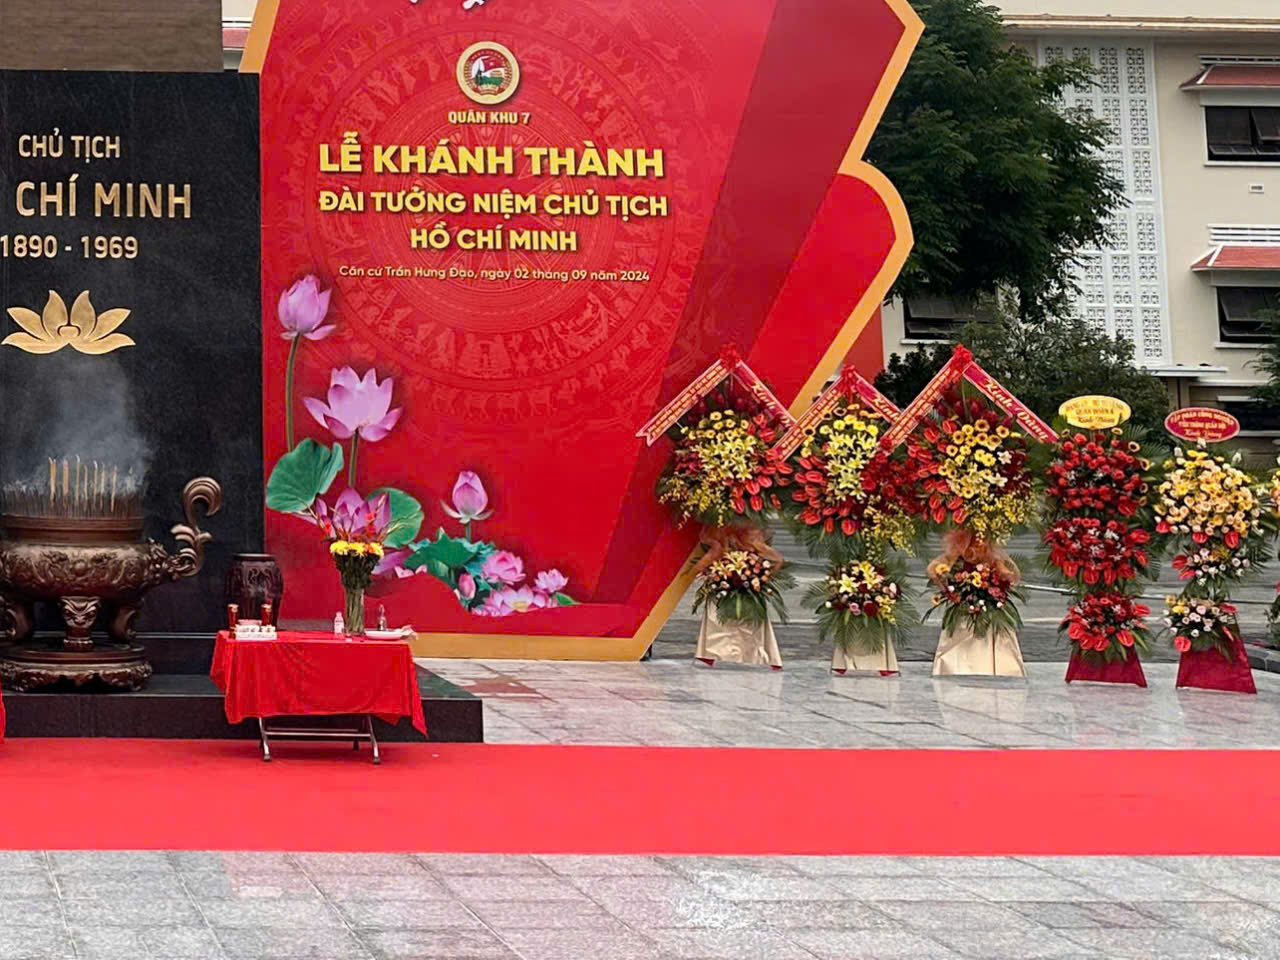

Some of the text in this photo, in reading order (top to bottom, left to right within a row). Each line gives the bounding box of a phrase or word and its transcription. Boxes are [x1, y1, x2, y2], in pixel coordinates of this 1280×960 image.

[448, 109, 530, 124] QUÂN KHU 7
[18, 127, 120, 164] CHỦ TỊCH
[319, 131, 664, 177] LỄ KHÁNH THÀNH
[16, 173, 79, 217] CHÍ
[94, 182, 191, 219] MINH
[318, 186, 667, 222] ĐÀI TƯỞNG NIỆM CHỦ TỊCH
[0, 234, 58, 259] 1890
[80, 235, 138, 259] 1969
[410, 221, 577, 251] HỒ CHÍ MINH
[414, 267, 446, 280] Hưng
[449, 267, 477, 279] Đạo,
[514, 268, 529, 279] 02
[571, 269, 587, 280] 09
[590, 268, 617, 280] năm
[620, 270, 650, 281] 2024
